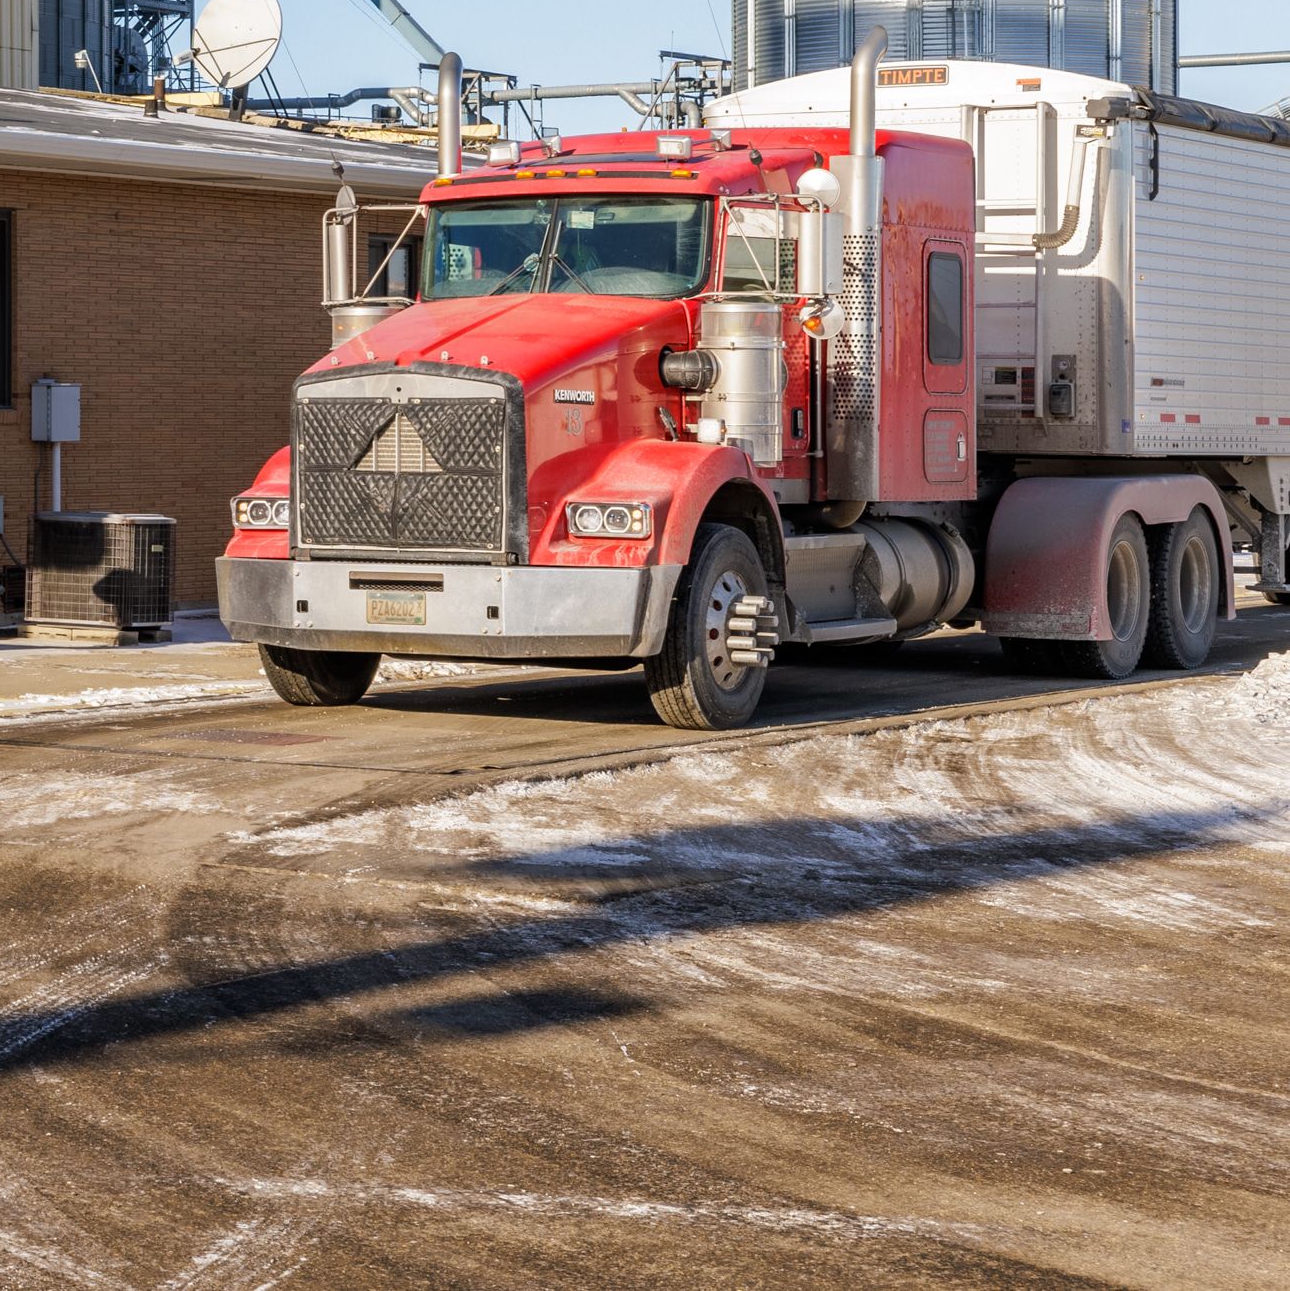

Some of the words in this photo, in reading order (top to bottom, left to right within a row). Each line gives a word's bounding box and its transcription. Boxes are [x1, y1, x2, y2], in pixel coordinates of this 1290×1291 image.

[880, 68, 945, 85] TIMPTE
[554, 389, 595, 402] KENWORTH
[371, 600, 415, 617] PZA6202
